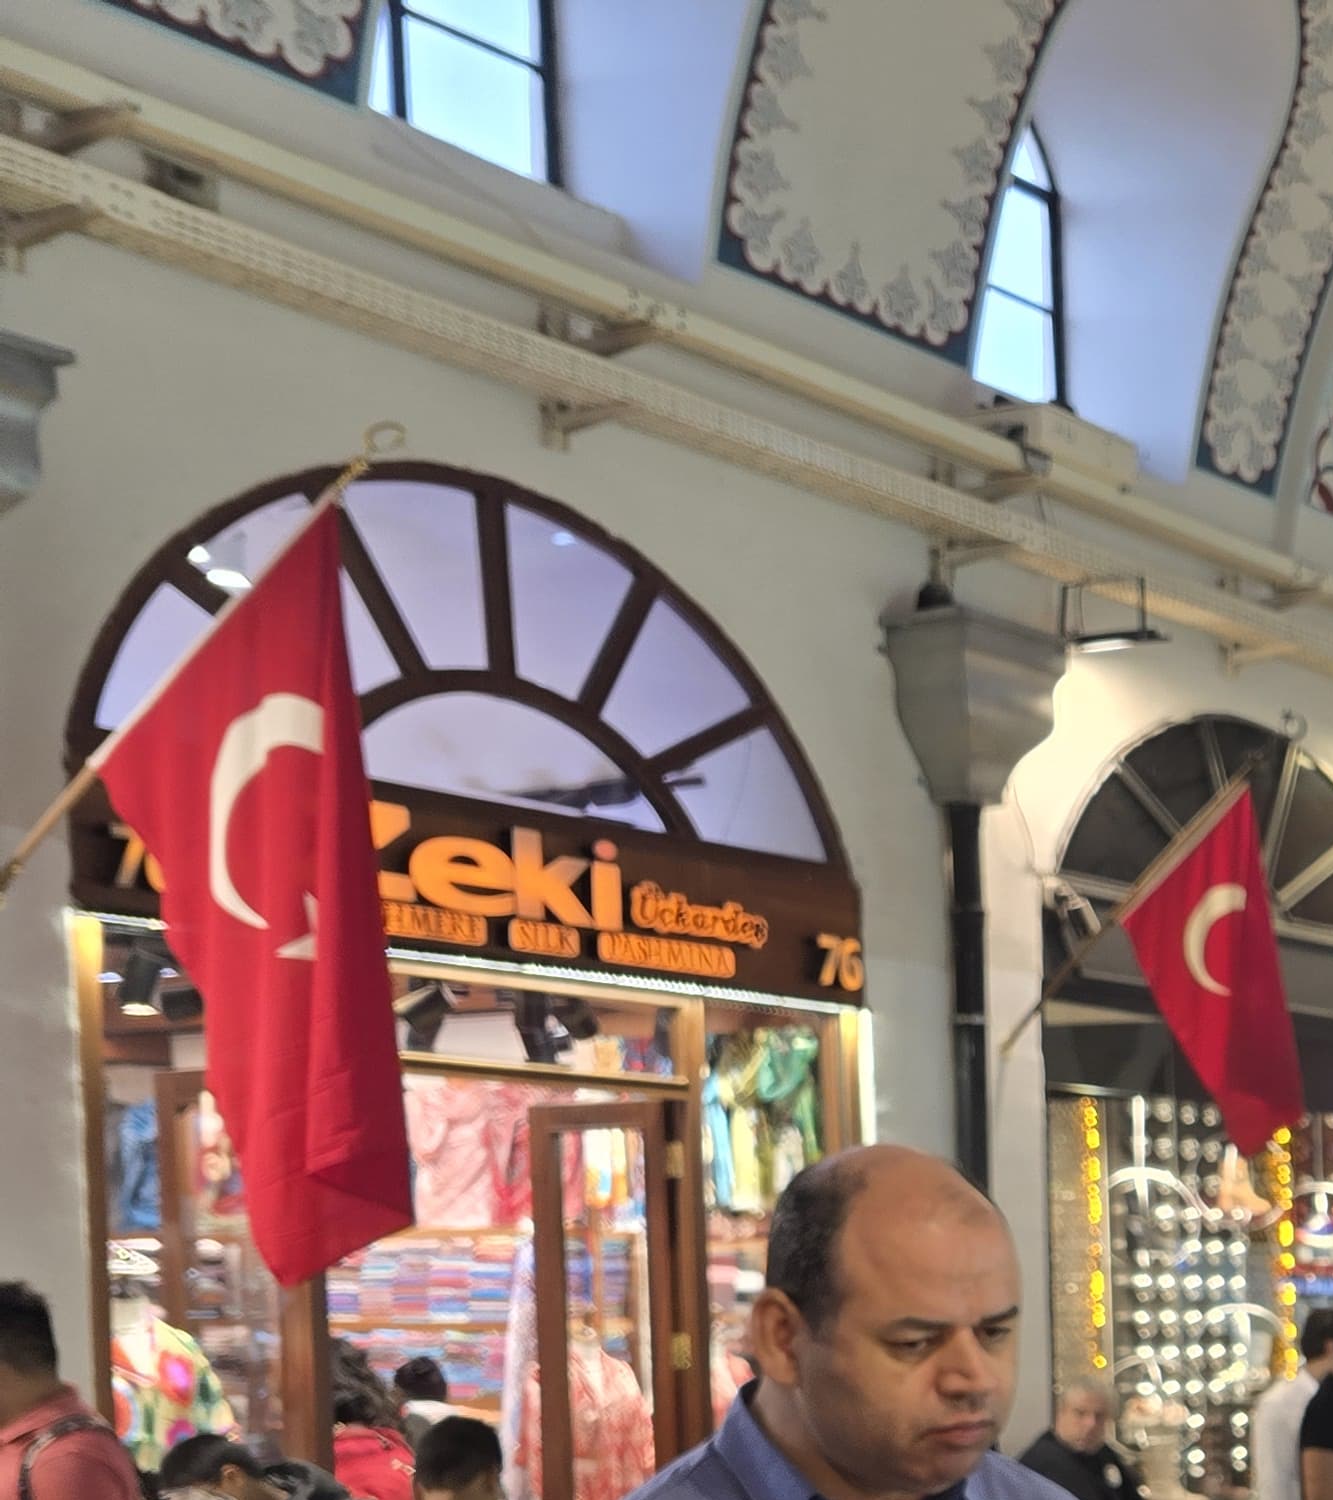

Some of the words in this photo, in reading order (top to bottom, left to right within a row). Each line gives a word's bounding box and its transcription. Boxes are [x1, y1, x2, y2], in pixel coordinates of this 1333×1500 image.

[514, 920, 579, 957] SILK
[602, 931, 734, 977] PASHMINA
[816, 933, 864, 992] 76
